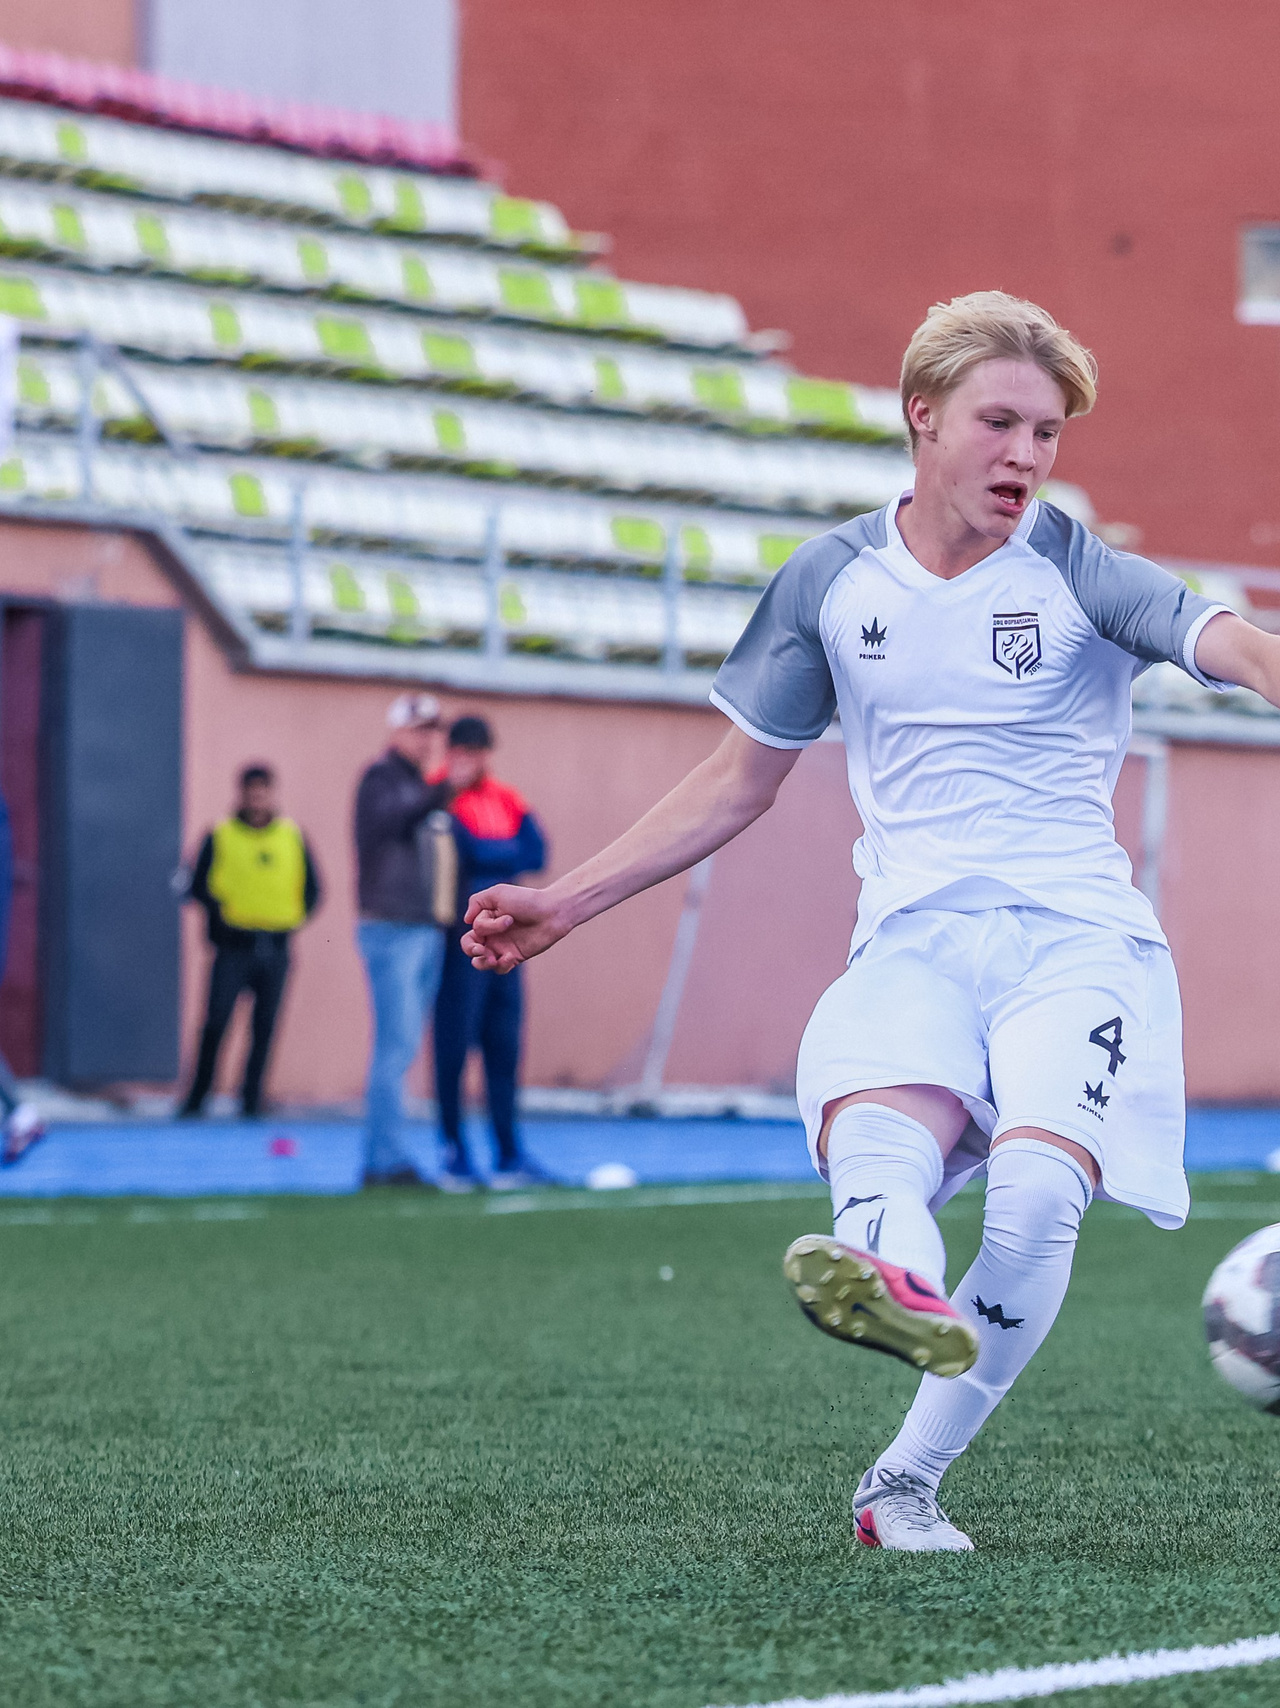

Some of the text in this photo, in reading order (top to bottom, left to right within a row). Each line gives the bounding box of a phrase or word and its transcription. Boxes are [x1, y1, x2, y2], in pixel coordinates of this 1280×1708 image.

[1028, 661, 1043, 676] 2015
[1088, 1015, 1127, 1078] 4
[1077, 1102, 1104, 1123] PRIMERA
